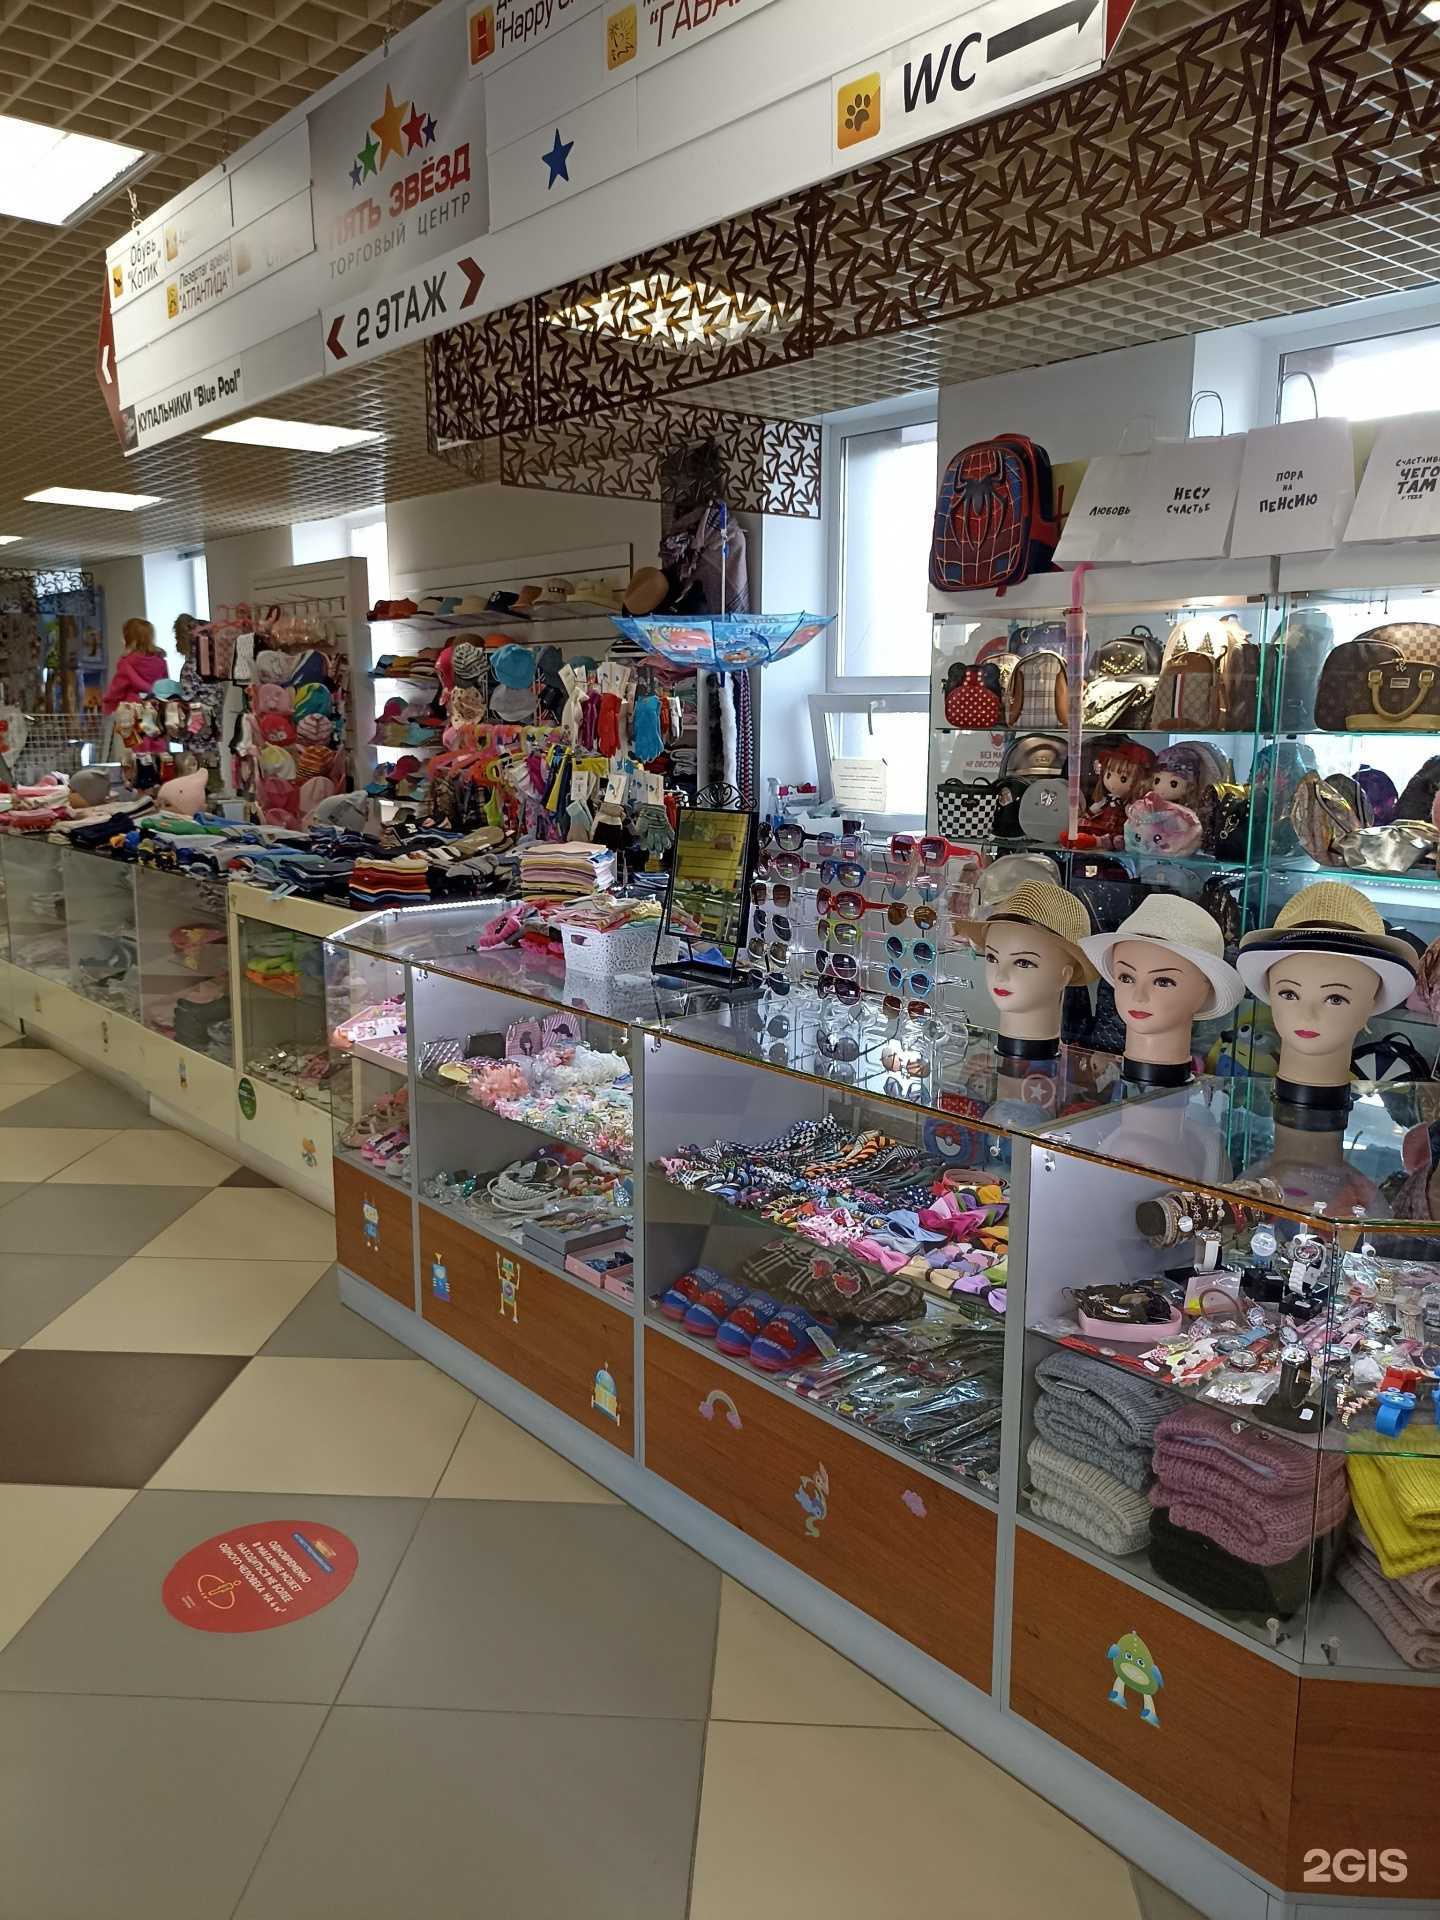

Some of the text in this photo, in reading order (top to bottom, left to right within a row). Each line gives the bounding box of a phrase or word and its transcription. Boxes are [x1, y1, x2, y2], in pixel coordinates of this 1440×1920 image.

[904, 32, 982, 113] WC
[329, 143, 471, 250] ПЯТЬ ЗВЁЗД
[329, 222, 406, 280] ТОРГОВЫЙ
[418, 191, 471, 237] ЦЕНТР
[357, 271, 448, 349] 2 ЭТАЖ
[137, 391, 193, 433] КУПАЛЬНИКИ
[1275, 470, 1304, 482] ПОРА
[1400, 466, 1440, 481] ЧЕГО
[1173, 486, 1211, 501] НЕСУ
[1282, 484, 1293, 492] НА
[1397, 478, 1438, 494] ТАМ
[1089, 505, 1131, 517] ЛЮБОВЬ
[1166, 502, 1211, 515] СЧАСТЬЕ
[1259, 493, 1318, 513] ПЕНСИЮ
